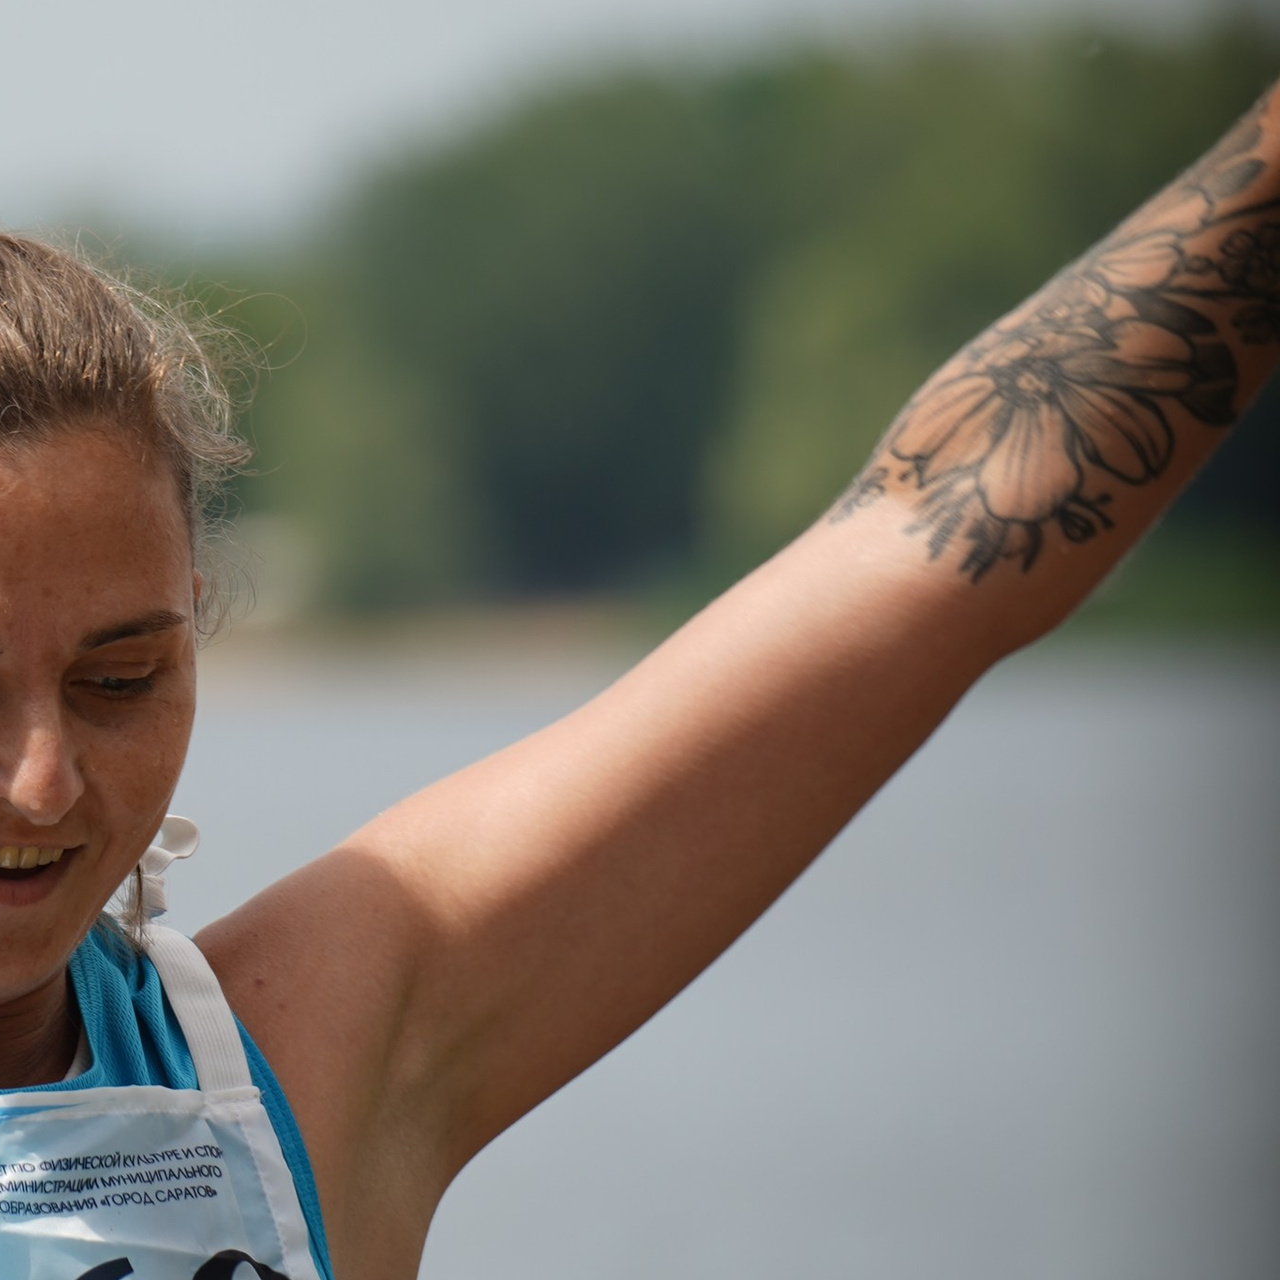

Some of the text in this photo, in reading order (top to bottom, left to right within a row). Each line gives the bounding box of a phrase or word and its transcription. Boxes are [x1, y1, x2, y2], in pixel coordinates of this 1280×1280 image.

[12, 1162, 36, 1174] ПО
[39, 1152, 121, 1172] ФИЗИЧЕСКОЙ
[122, 1149, 181, 1168] КУЛЬТУРЕ
[181, 1148, 194, 1159] И
[100, 1165, 223, 1189] МУНИЦИПАЛЬНОГО
